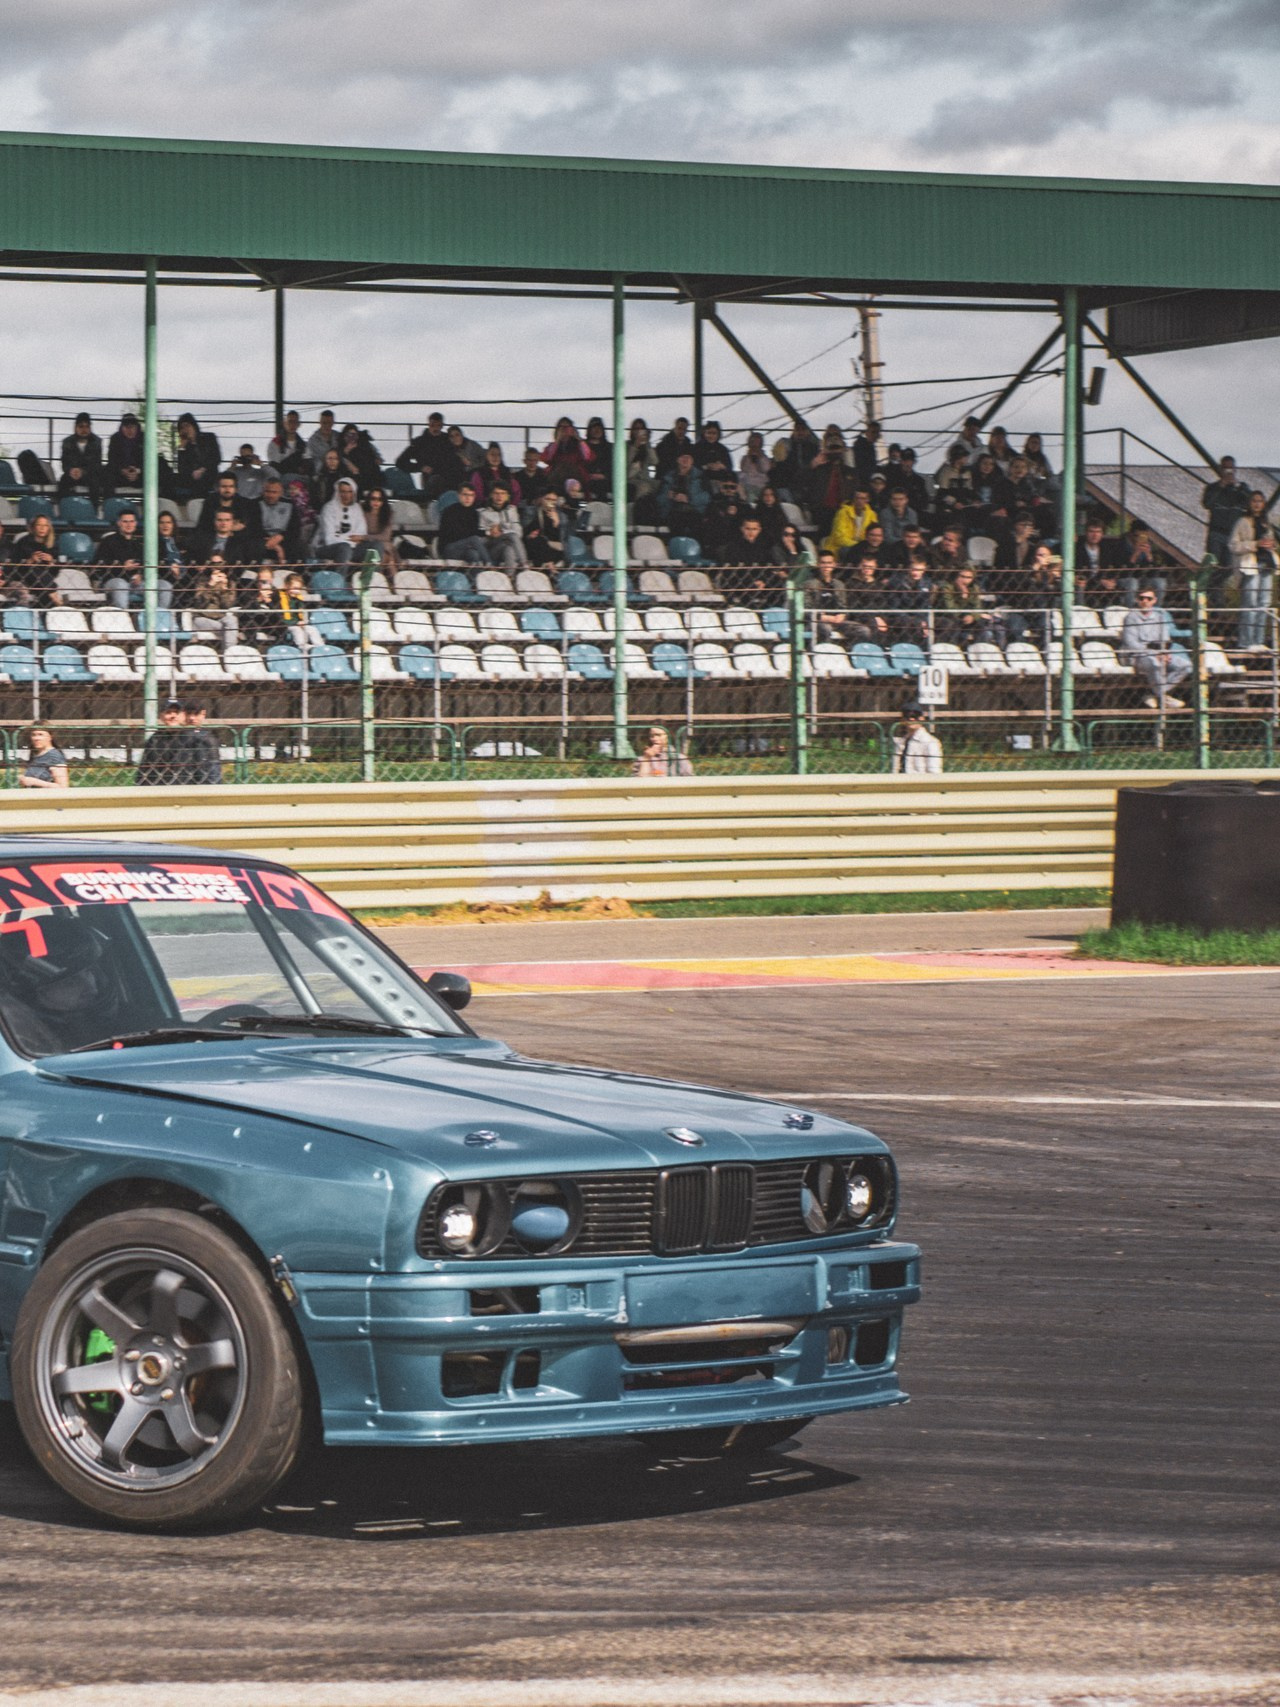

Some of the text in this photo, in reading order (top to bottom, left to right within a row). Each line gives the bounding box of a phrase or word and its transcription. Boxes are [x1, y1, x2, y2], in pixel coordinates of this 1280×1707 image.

[922, 668, 942, 687] 10
[60, 871, 236, 887] BURNING TIRES
[75, 884, 251, 902] CHALLENGE
